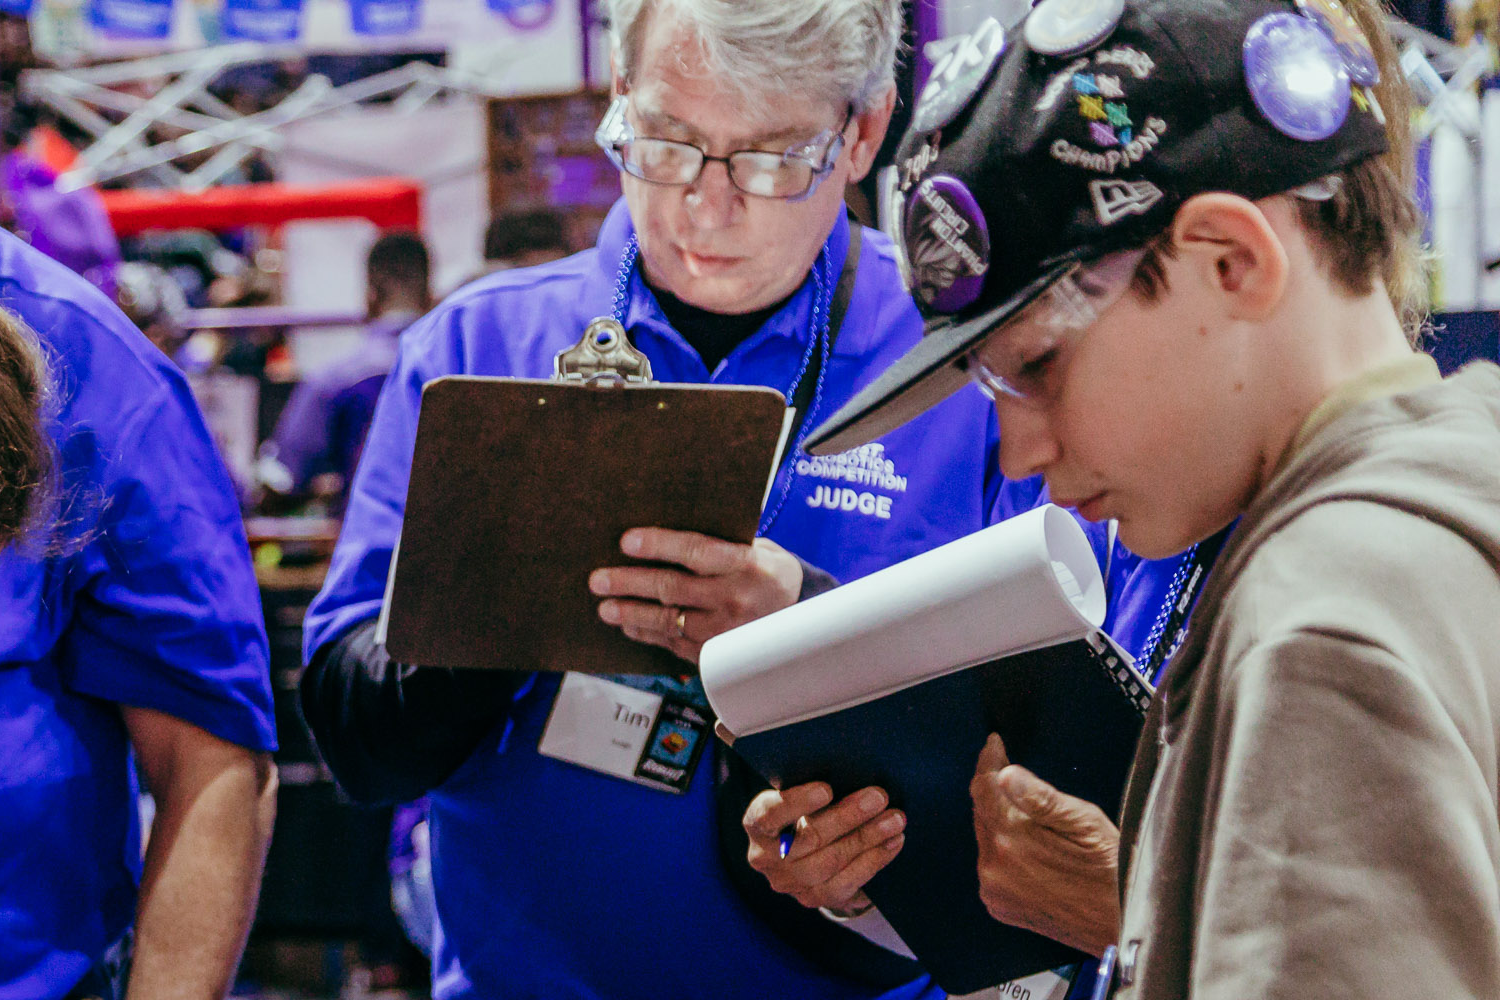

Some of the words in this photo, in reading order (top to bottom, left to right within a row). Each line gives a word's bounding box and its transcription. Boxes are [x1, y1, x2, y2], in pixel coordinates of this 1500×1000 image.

[796, 459, 908, 493] COMPETITION
[806, 485, 894, 520] JUDGE
[614, 702, 651, 730] Tim
